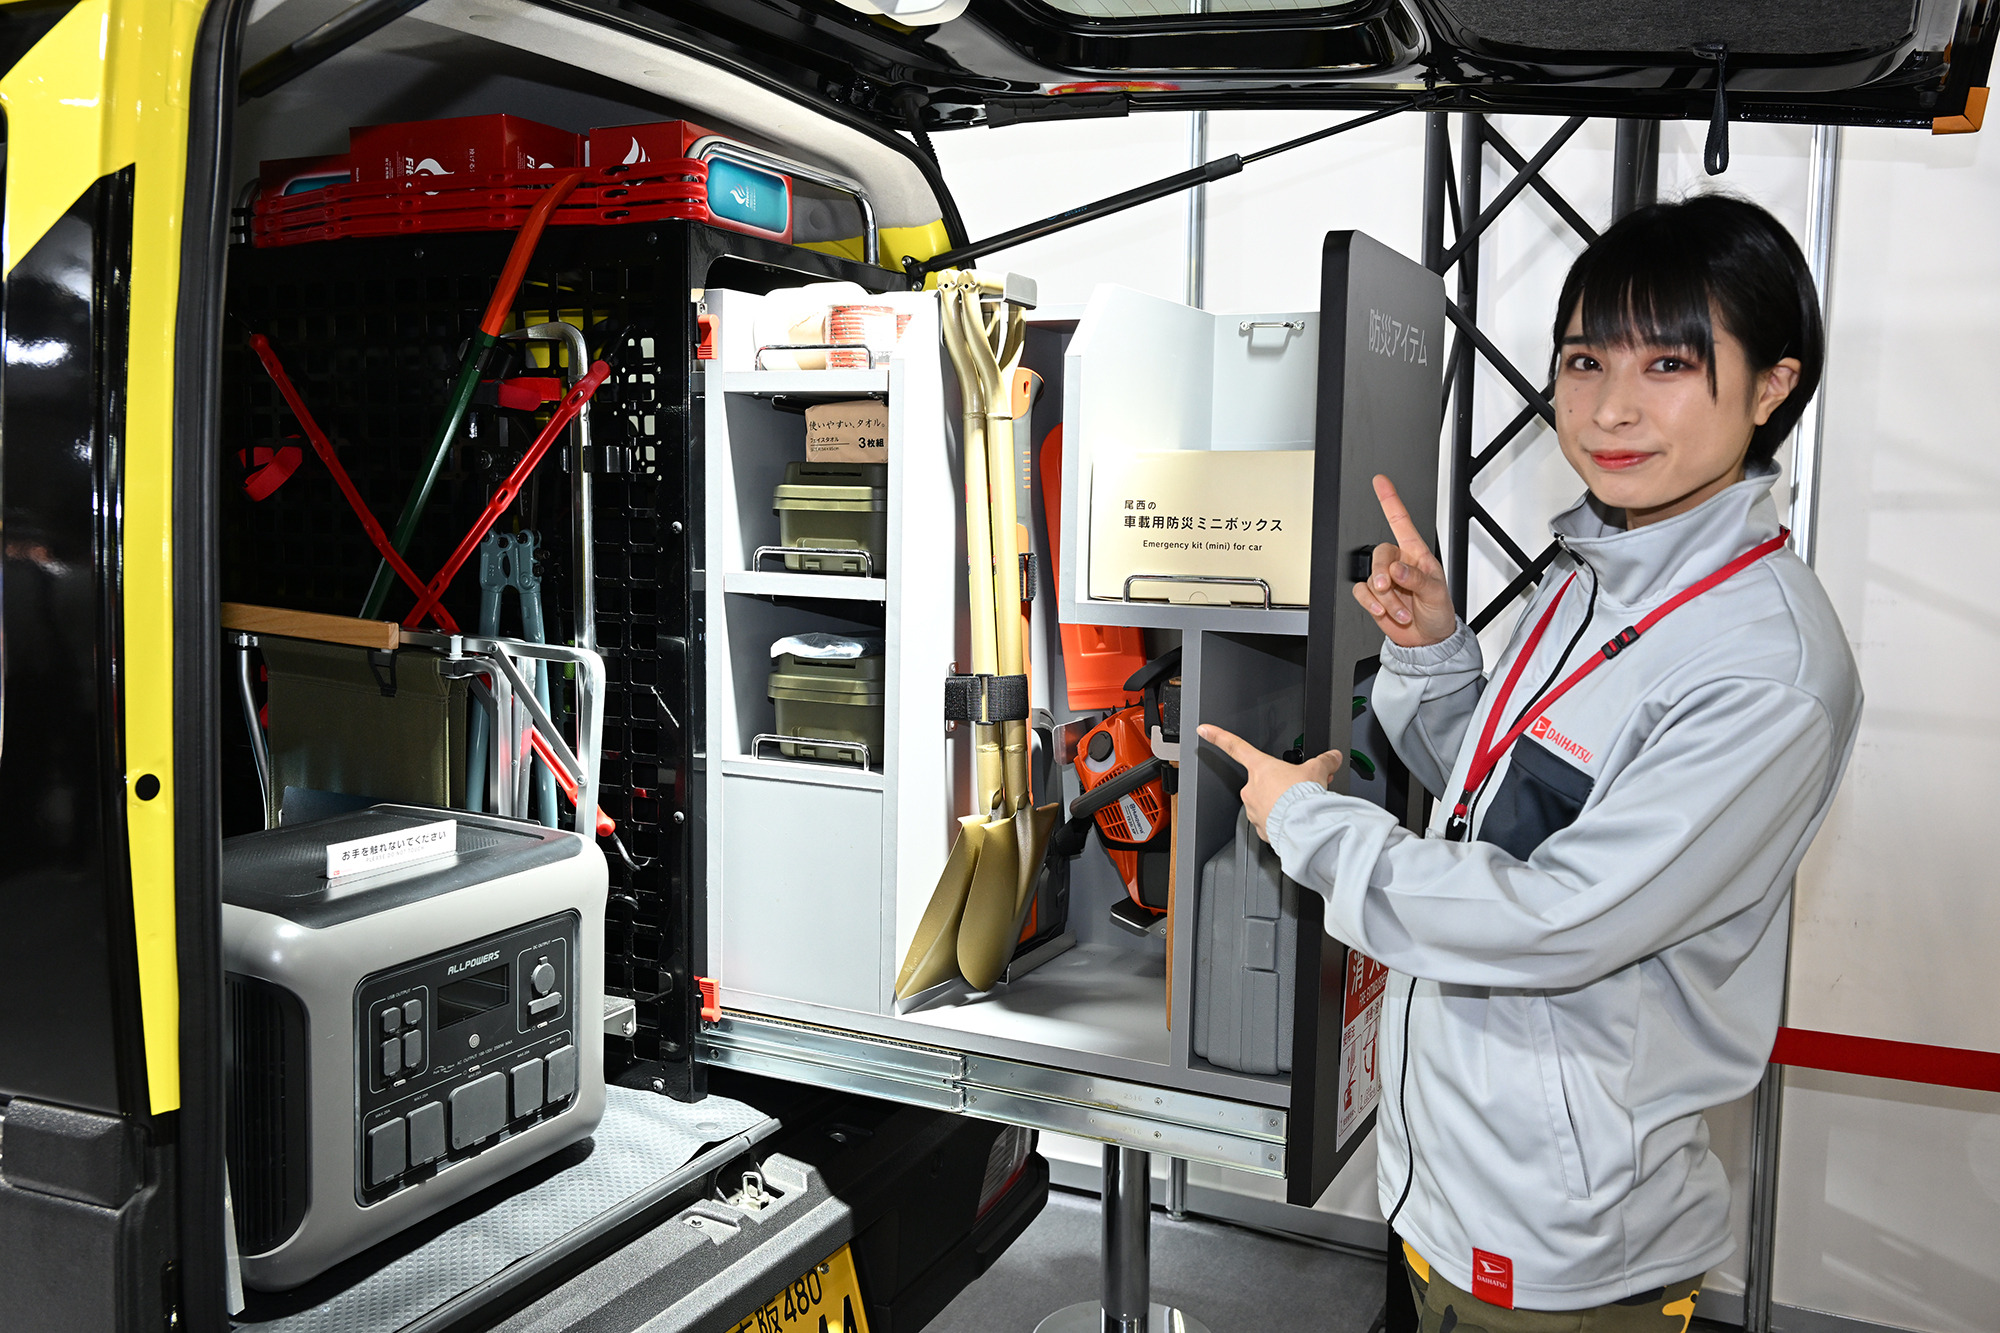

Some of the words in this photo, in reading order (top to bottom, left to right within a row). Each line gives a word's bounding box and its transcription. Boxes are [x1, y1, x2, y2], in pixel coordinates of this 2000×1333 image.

[1368, 308, 1428, 367] 防災アイテム
[809, 418, 886, 432] 使いやすい、タオル。
[858, 436, 885, 449] 3枚組
[1124, 499, 1157, 510] 尾西の
[1124, 515, 1283, 532] 車載用防災ミニボックス
[1142, 540, 1189, 550] Emergency
[1191, 541, 1203, 550] kit
[1205, 541, 1230, 551] (mini)
[1233, 542, 1246, 551] for
[1546, 727, 1594, 764] DAIHATSU
[447, 950, 500, 976] ALLPOWERS
[1477, 1274, 1508, 1290] DAIHATSU
[785, 1268, 823, 1323] 480
